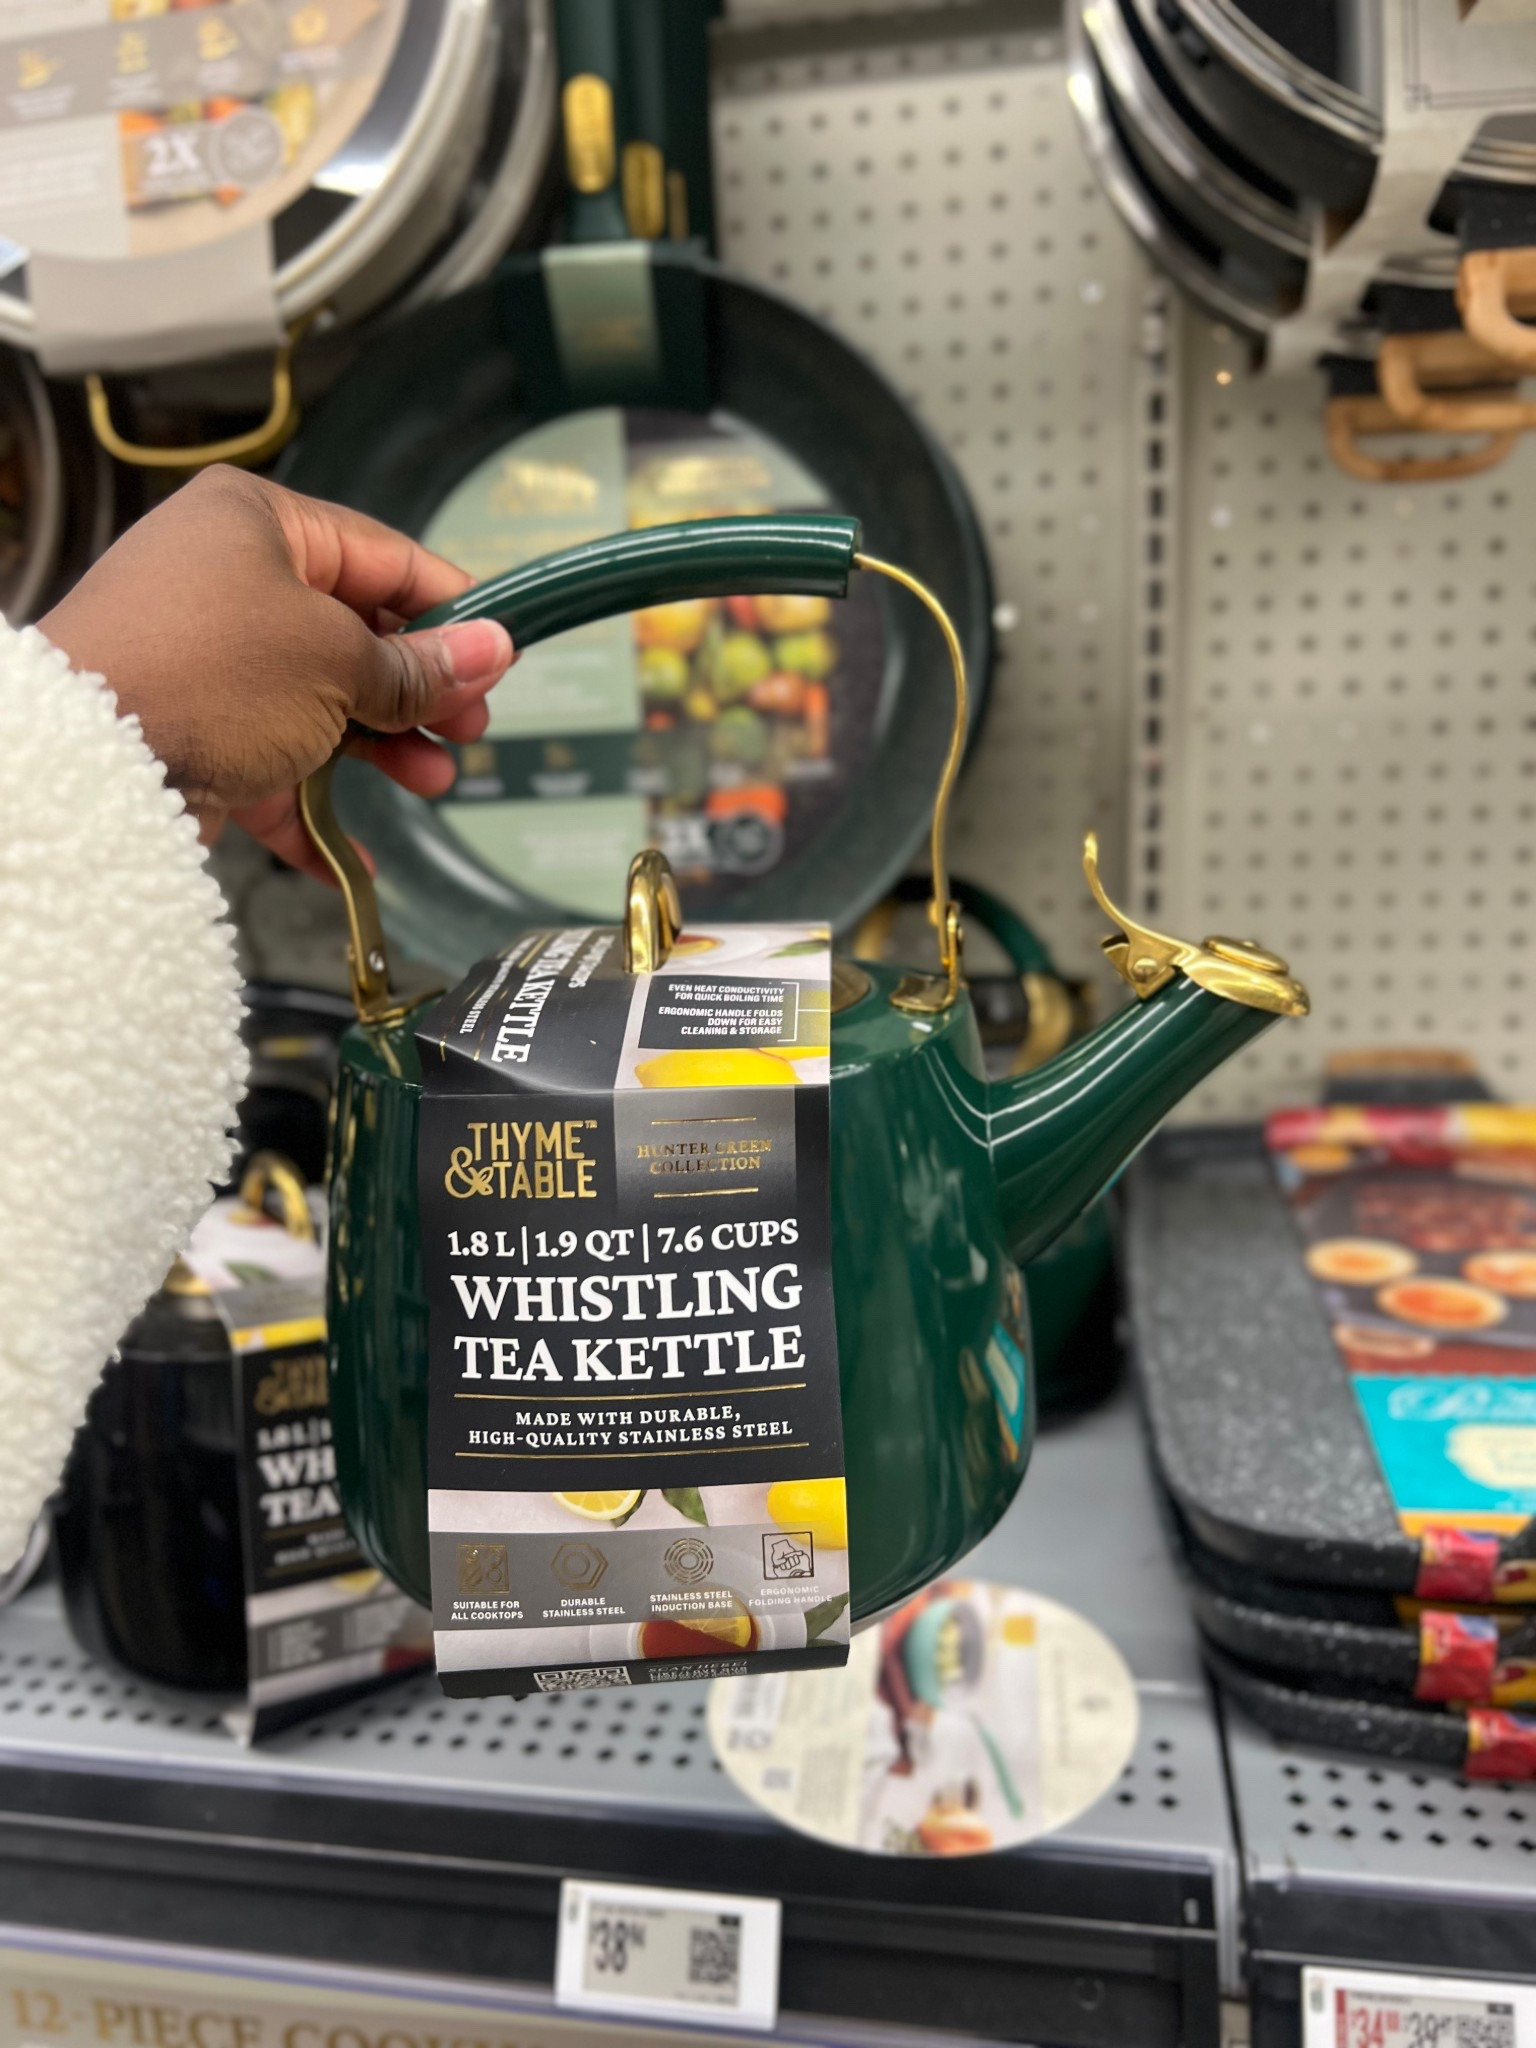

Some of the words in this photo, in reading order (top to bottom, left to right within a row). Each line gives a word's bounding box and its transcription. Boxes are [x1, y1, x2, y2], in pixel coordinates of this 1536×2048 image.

[668, 984, 692, 992] EVEN
[694, 984, 718, 993] HEAT
[718, 985, 785, 995] CONDUCTIVITY
[675, 992, 693, 1000] FOR
[694, 993, 722, 1002] QUICK
[723, 993, 760, 1003] BOILING
[761, 995, 784, 1003] TIME
[658, 1007, 713, 1017] ERGONOMIC
[715, 1008, 752, 1017] HANDLE
[753, 1009, 784, 1018] FOLDS
[460, 1010, 482, 1034] STEEL
[491, 979, 556, 1063] KETTLE
[707, 1017, 737, 1026] DOWN
[738, 1018, 757, 1026] FOR
[758, 1018, 783, 1026] EASY
[681, 1026, 728, 1035] CLEANING
[729, 1027, 738, 1035] &
[739, 1026, 782, 1035] STORAGE
[637, 1143, 710, 1159] HUNTER
[715, 1139, 773, 1154] GREEN
[650, 1155, 761, 1175] COLLECTION
[447, 1229, 489, 1257] 1.8
[535, 1229, 578, 1258] 1.9
[585, 1229, 635, 1262] QT
[657, 1225, 704, 1254] 7.6
[711, 1218, 799, 1250] CUPS
[450, 1262, 803, 1323] WHISTLING
[454, 1335, 563, 1382] TEA
[571, 1324, 806, 1382] KETTLE
[516, 1411, 572, 1426] MADE
[578, 1410, 633, 1425] WITH
[639, 1405, 742, 1424] DURABLE,
[468, 1430, 612, 1448] HIGH-QUALITY
[619, 1426, 726, 1444] STAINLESS
[732, 1420, 793, 1437] STEEL
[650, 1592, 702, 1602] STAINLESS
[703, 1590, 733, 1599] STEEL
[760, 1586, 820, 1596] ERGONOMIC
[453, 1601, 498, 1610] SUITABLE
[500, 1600, 520, 1609] FOR
[560, 1597, 606, 1607] DURABLE
[651, 1602, 706, 1612] INDUCTION
[708, 1601, 733, 1610] BASE
[749, 1597, 792, 1607] FOLDING
[793, 1594, 833, 1604] HANDLE
[451, 1611, 469, 1620] ALL
[470, 1611, 524, 1620] COOKTOPS
[542, 1608, 594, 1618] STAINLESS
[596, 1606, 626, 1616] STEEL
